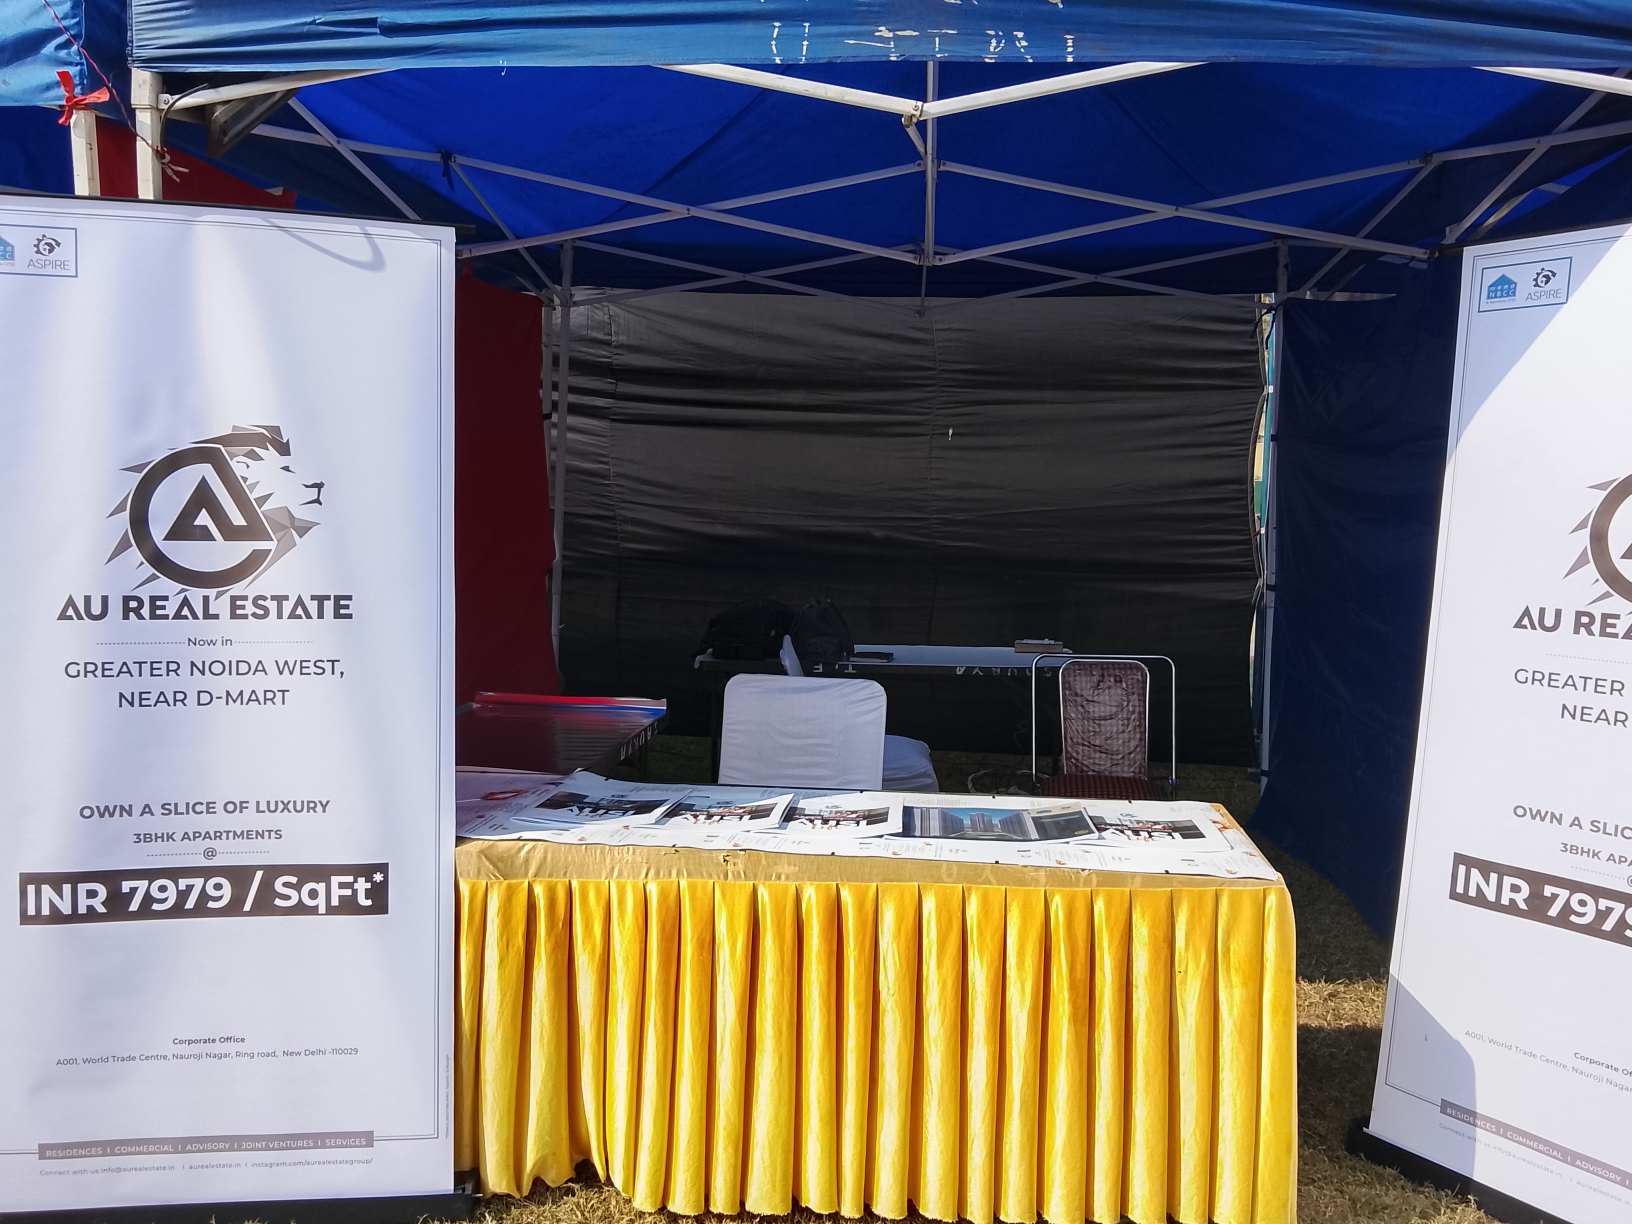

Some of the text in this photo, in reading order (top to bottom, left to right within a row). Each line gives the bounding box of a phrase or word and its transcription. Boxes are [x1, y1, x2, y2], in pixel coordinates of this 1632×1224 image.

[27, 258, 72, 271] ASPIRE
[1525, 288, 1563, 302] ASPIRE
[56, 594, 354, 621] AU REAL ESTATE
[1512, 605, 1562, 632] AU
[187, 636, 233, 647] Now in
[64, 658, 345, 680] GREATER NOIDA WEST,
[1514, 668, 1625, 697] GREATER
[118, 688, 290, 708] NEAR D-MART
[1561, 703, 1629, 728] NEAR
[79, 799, 331, 820] OWN A SLICE OF LUXURY
[1513, 805, 1563, 826] OWN
[1569, 816, 1583, 830] A
[133, 829, 283, 844] 3BHK APARTMENTS
[202, 846, 218, 861] @
[1560, 842, 1602, 860] 3BHK
[26, 881, 109, 917] INR
[121, 876, 232, 912] 7979
[242, 870, 264, 912] /
[1456, 863, 1530, 911] INR
[172, 1035, 246, 1047] Corporate Office
[1488, 1036, 1513, 1051] World
[1514, 1045, 1538, 1061] Trade
[82, 1055, 110, 1066] World
[111, 1054, 137, 1064] Trade
[138, 1053, 170, 1063] Centre,
[172, 1051, 203, 1063] Nauroji
[204, 1050, 233, 1063] Nagar,
[235, 1049, 255, 1062] Ring
[282, 1048, 302, 1059] New
[303, 1047, 327, 1058] Delhi
[1573, 1051, 1620, 1073] Corporate
[45, 1147, 103, 1159] RESIDENCES
[114, 1143, 175, 1155] COMMERCIAL
[185, 1142, 230, 1152] ADVISORY
[240, 1140, 267, 1150] JOINT
[268, 1138, 314, 1149] VENTURES
[324, 1136, 367, 1147] SERVICES
[1445, 1107, 1497, 1132] RESIDENCES
[1506, 1131, 1564, 1161] COMMERCIAL
[1574, 1158, 1622, 1182] ADVISORY
